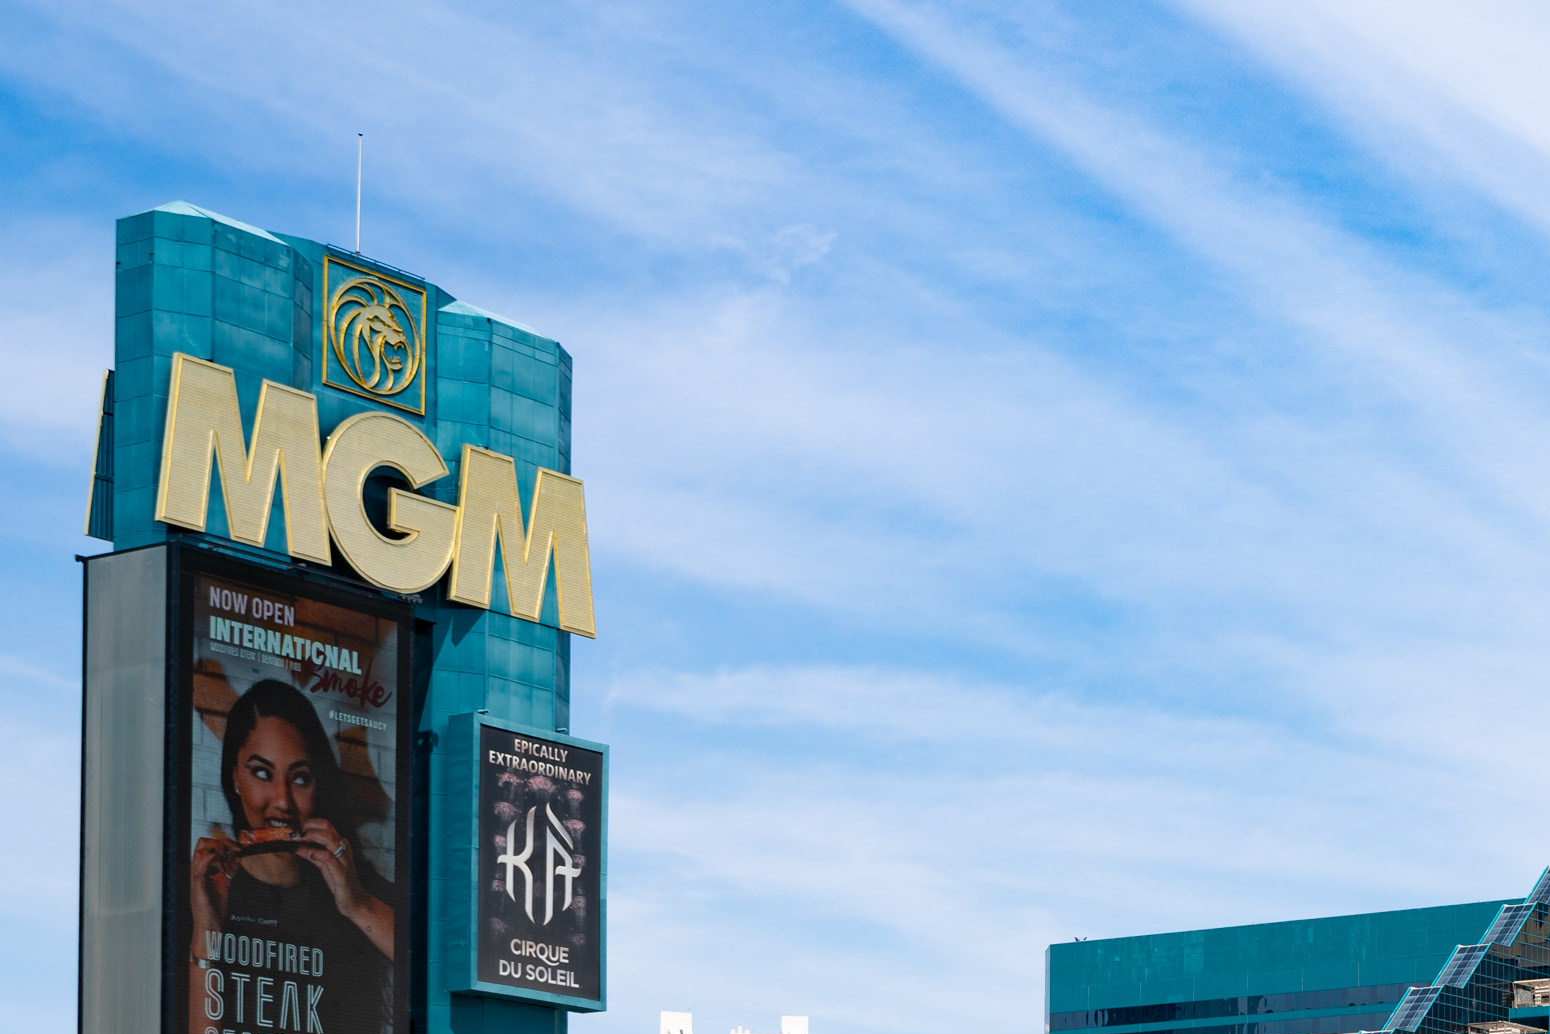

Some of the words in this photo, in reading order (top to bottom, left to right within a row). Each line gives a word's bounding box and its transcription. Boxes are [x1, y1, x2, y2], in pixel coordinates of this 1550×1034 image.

[155, 352, 596, 638] MGM
[210, 586, 248, 615] NOW
[252, 597, 295, 627] OPEN
[329, 710, 387, 731] #LETSGETSAUCY
[489, 750, 591, 785] EXTRAORDINARY
[514, 738, 568, 763] EPICALLY
[205, 930, 323, 977] WOODFIRED
[510, 938, 569, 967] CIRQUE
[499, 959, 522, 979] DU
[526, 964, 579, 988] SOLEIL
[205, 968, 324, 1034] STEAK
